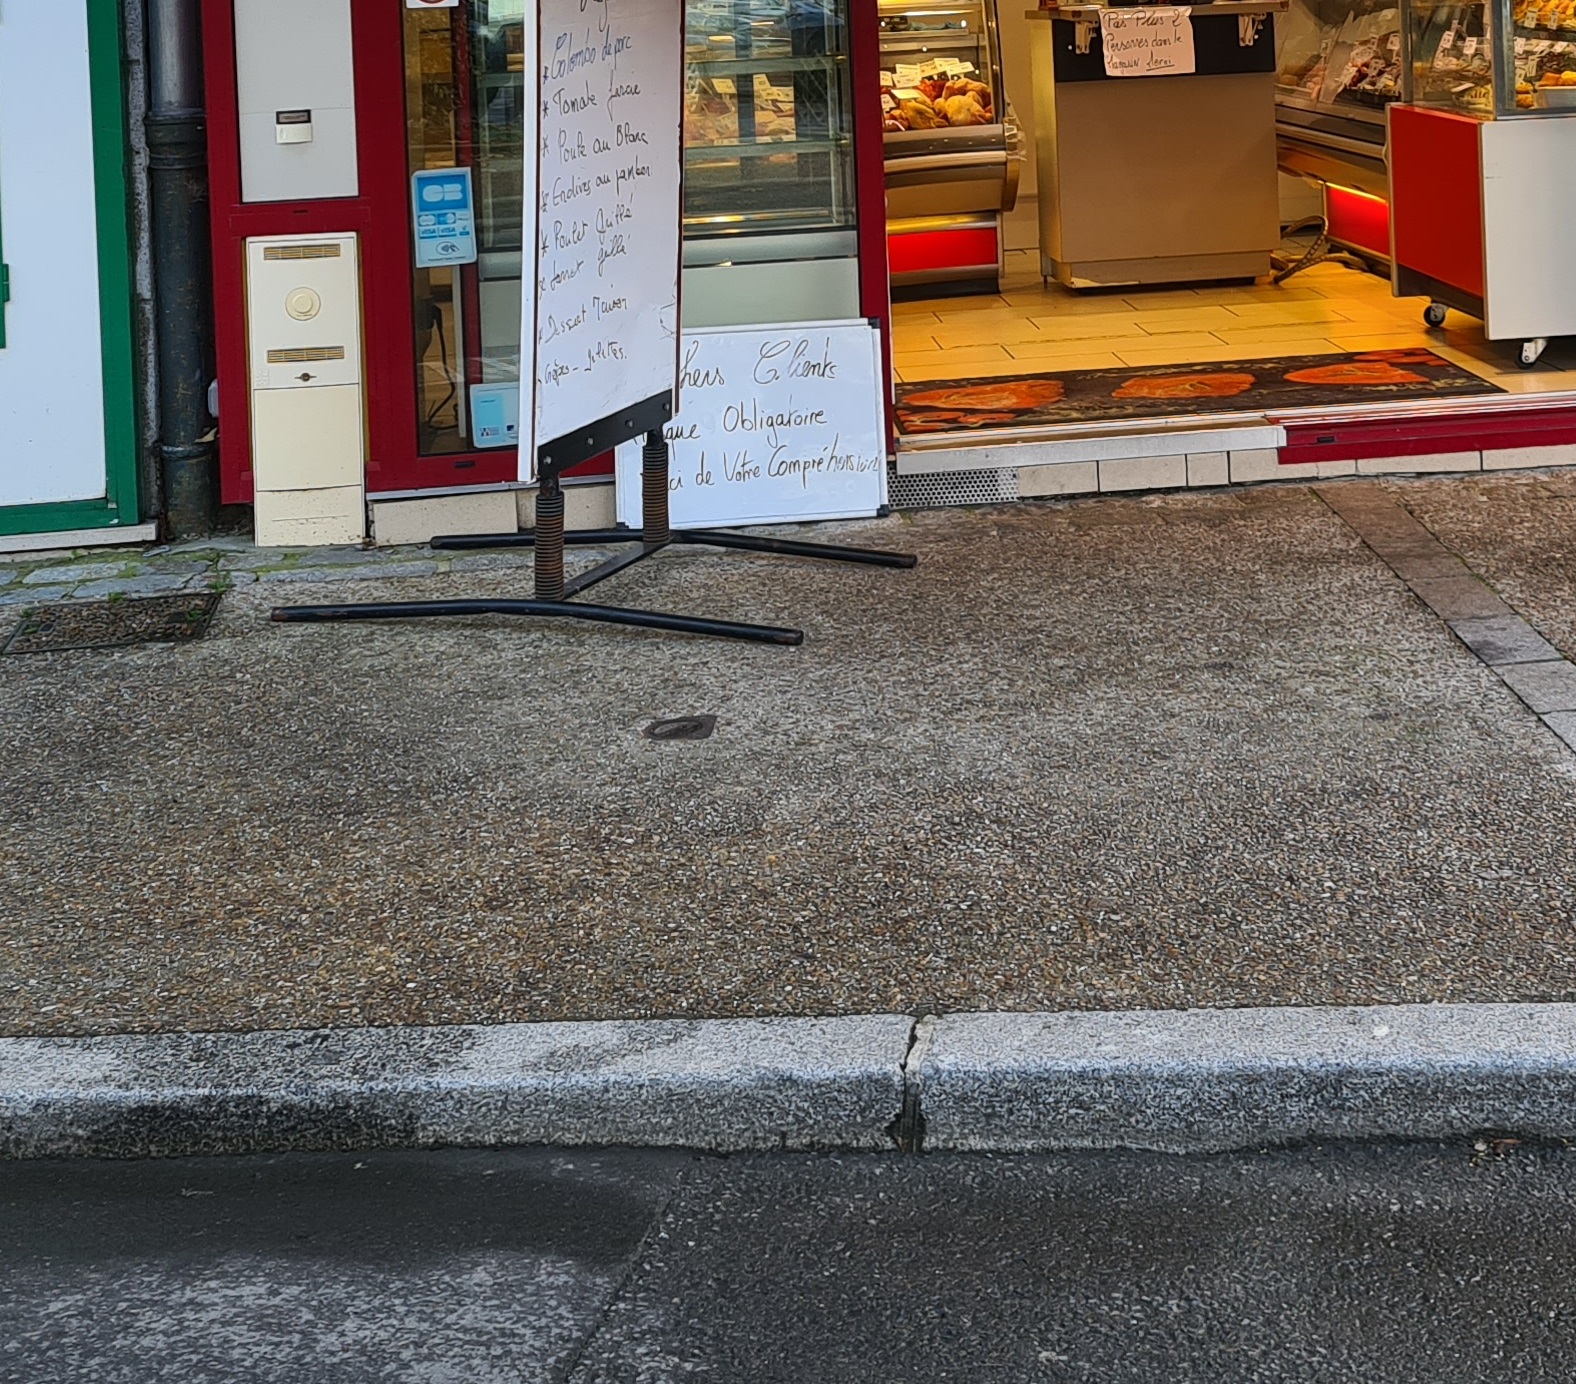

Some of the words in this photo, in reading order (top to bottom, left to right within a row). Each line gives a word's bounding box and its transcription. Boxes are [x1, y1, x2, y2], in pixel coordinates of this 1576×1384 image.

[1103, 11, 1127, 28] Pas
[1131, 10, 1165, 27] Plus
[553, 80, 598, 115] Tomate
[680, 339, 726, 389] hers
[723, 394, 828, 449] Obligatoire
[695, 451, 715, 487] de
[722, 450, 761, 482] Votre
